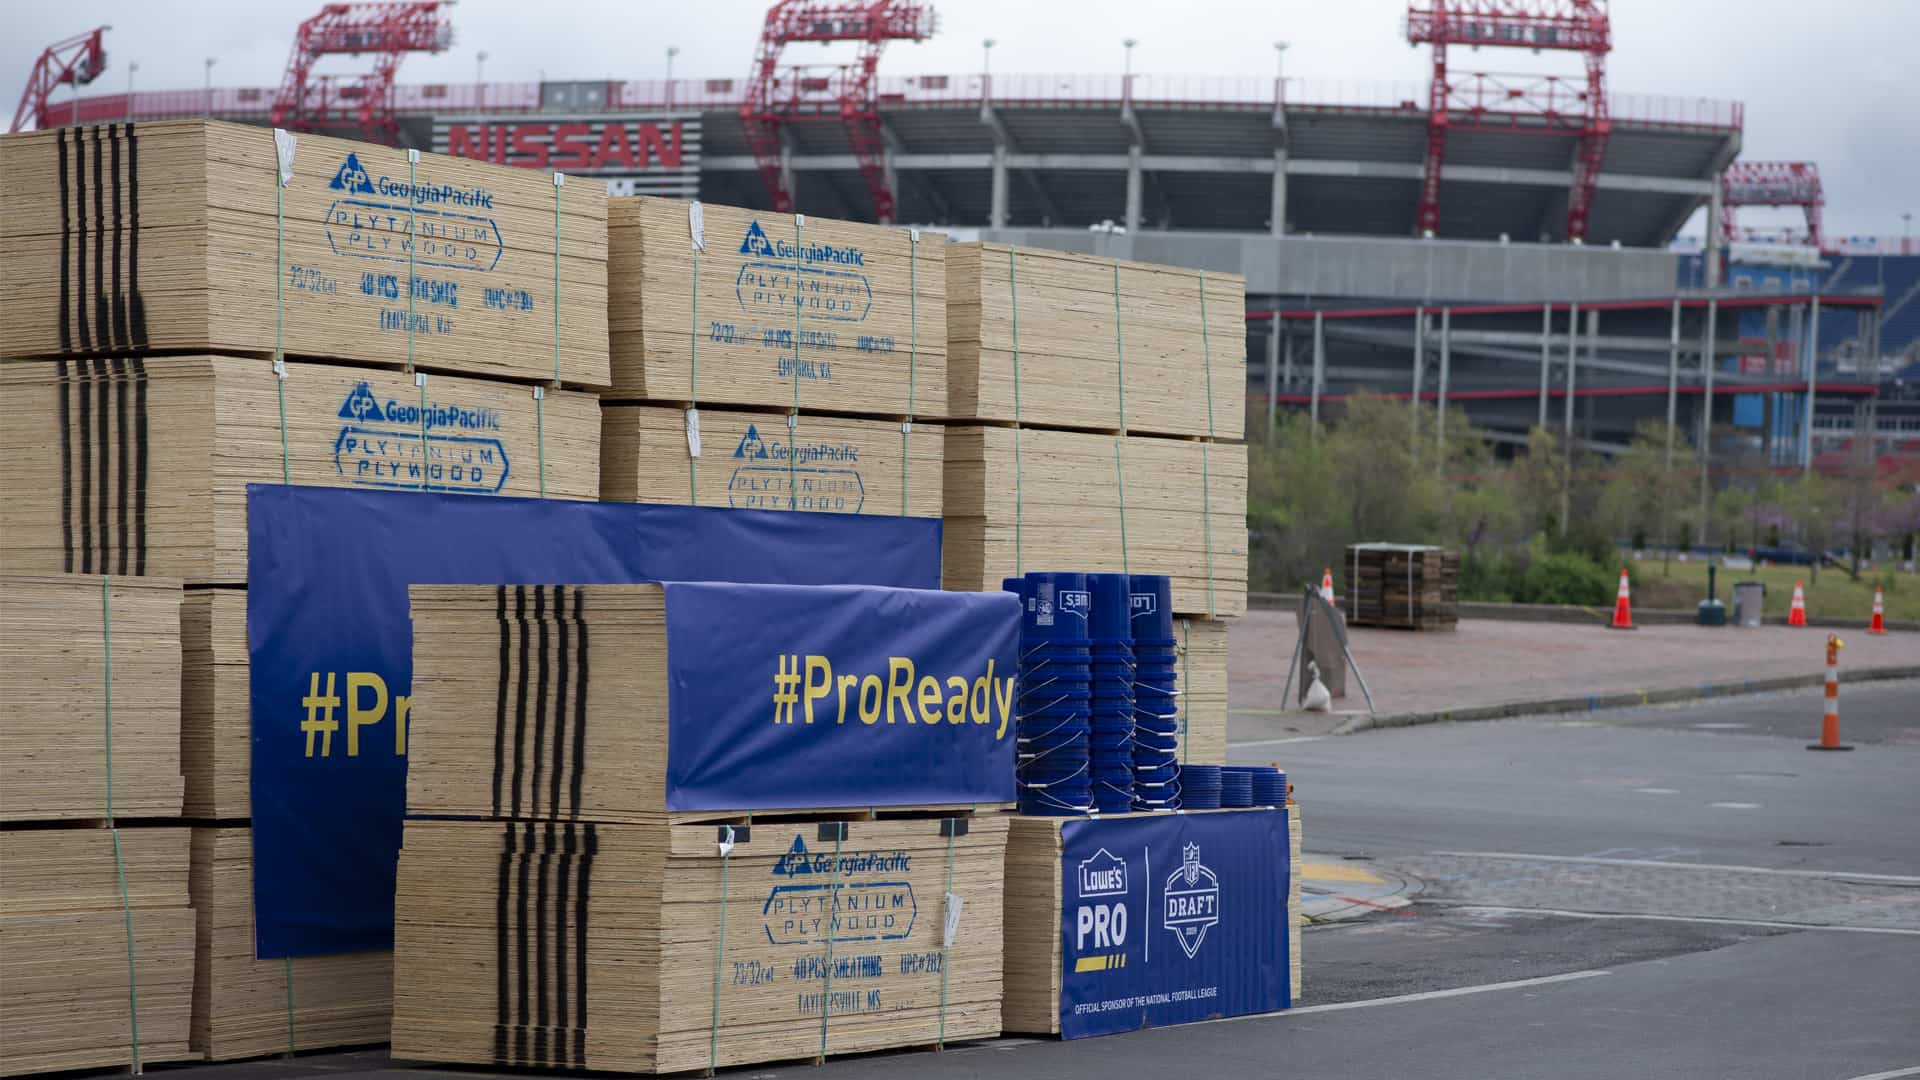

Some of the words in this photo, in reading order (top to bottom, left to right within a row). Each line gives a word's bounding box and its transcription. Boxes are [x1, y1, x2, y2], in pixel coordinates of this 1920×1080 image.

[447, 122, 683, 168] NISSAN
[773, 654, 1014, 740] #ProReady
[1077, 902, 1127, 950] PRO
[1168, 895, 1215, 918] DRAFT
[1074, 1003, 1100, 1015] OFFICIAL
[1101, 999, 1126, 1011] SPONSOR
[1127, 998, 1135, 1008] OF
[1135, 996, 1145, 1007] THE
[1146, 993, 1170, 1005] NATIONAL
[1172, 990, 1197, 1002] FOOTBALL
[1198, 987, 1217, 999] LEAGUE
